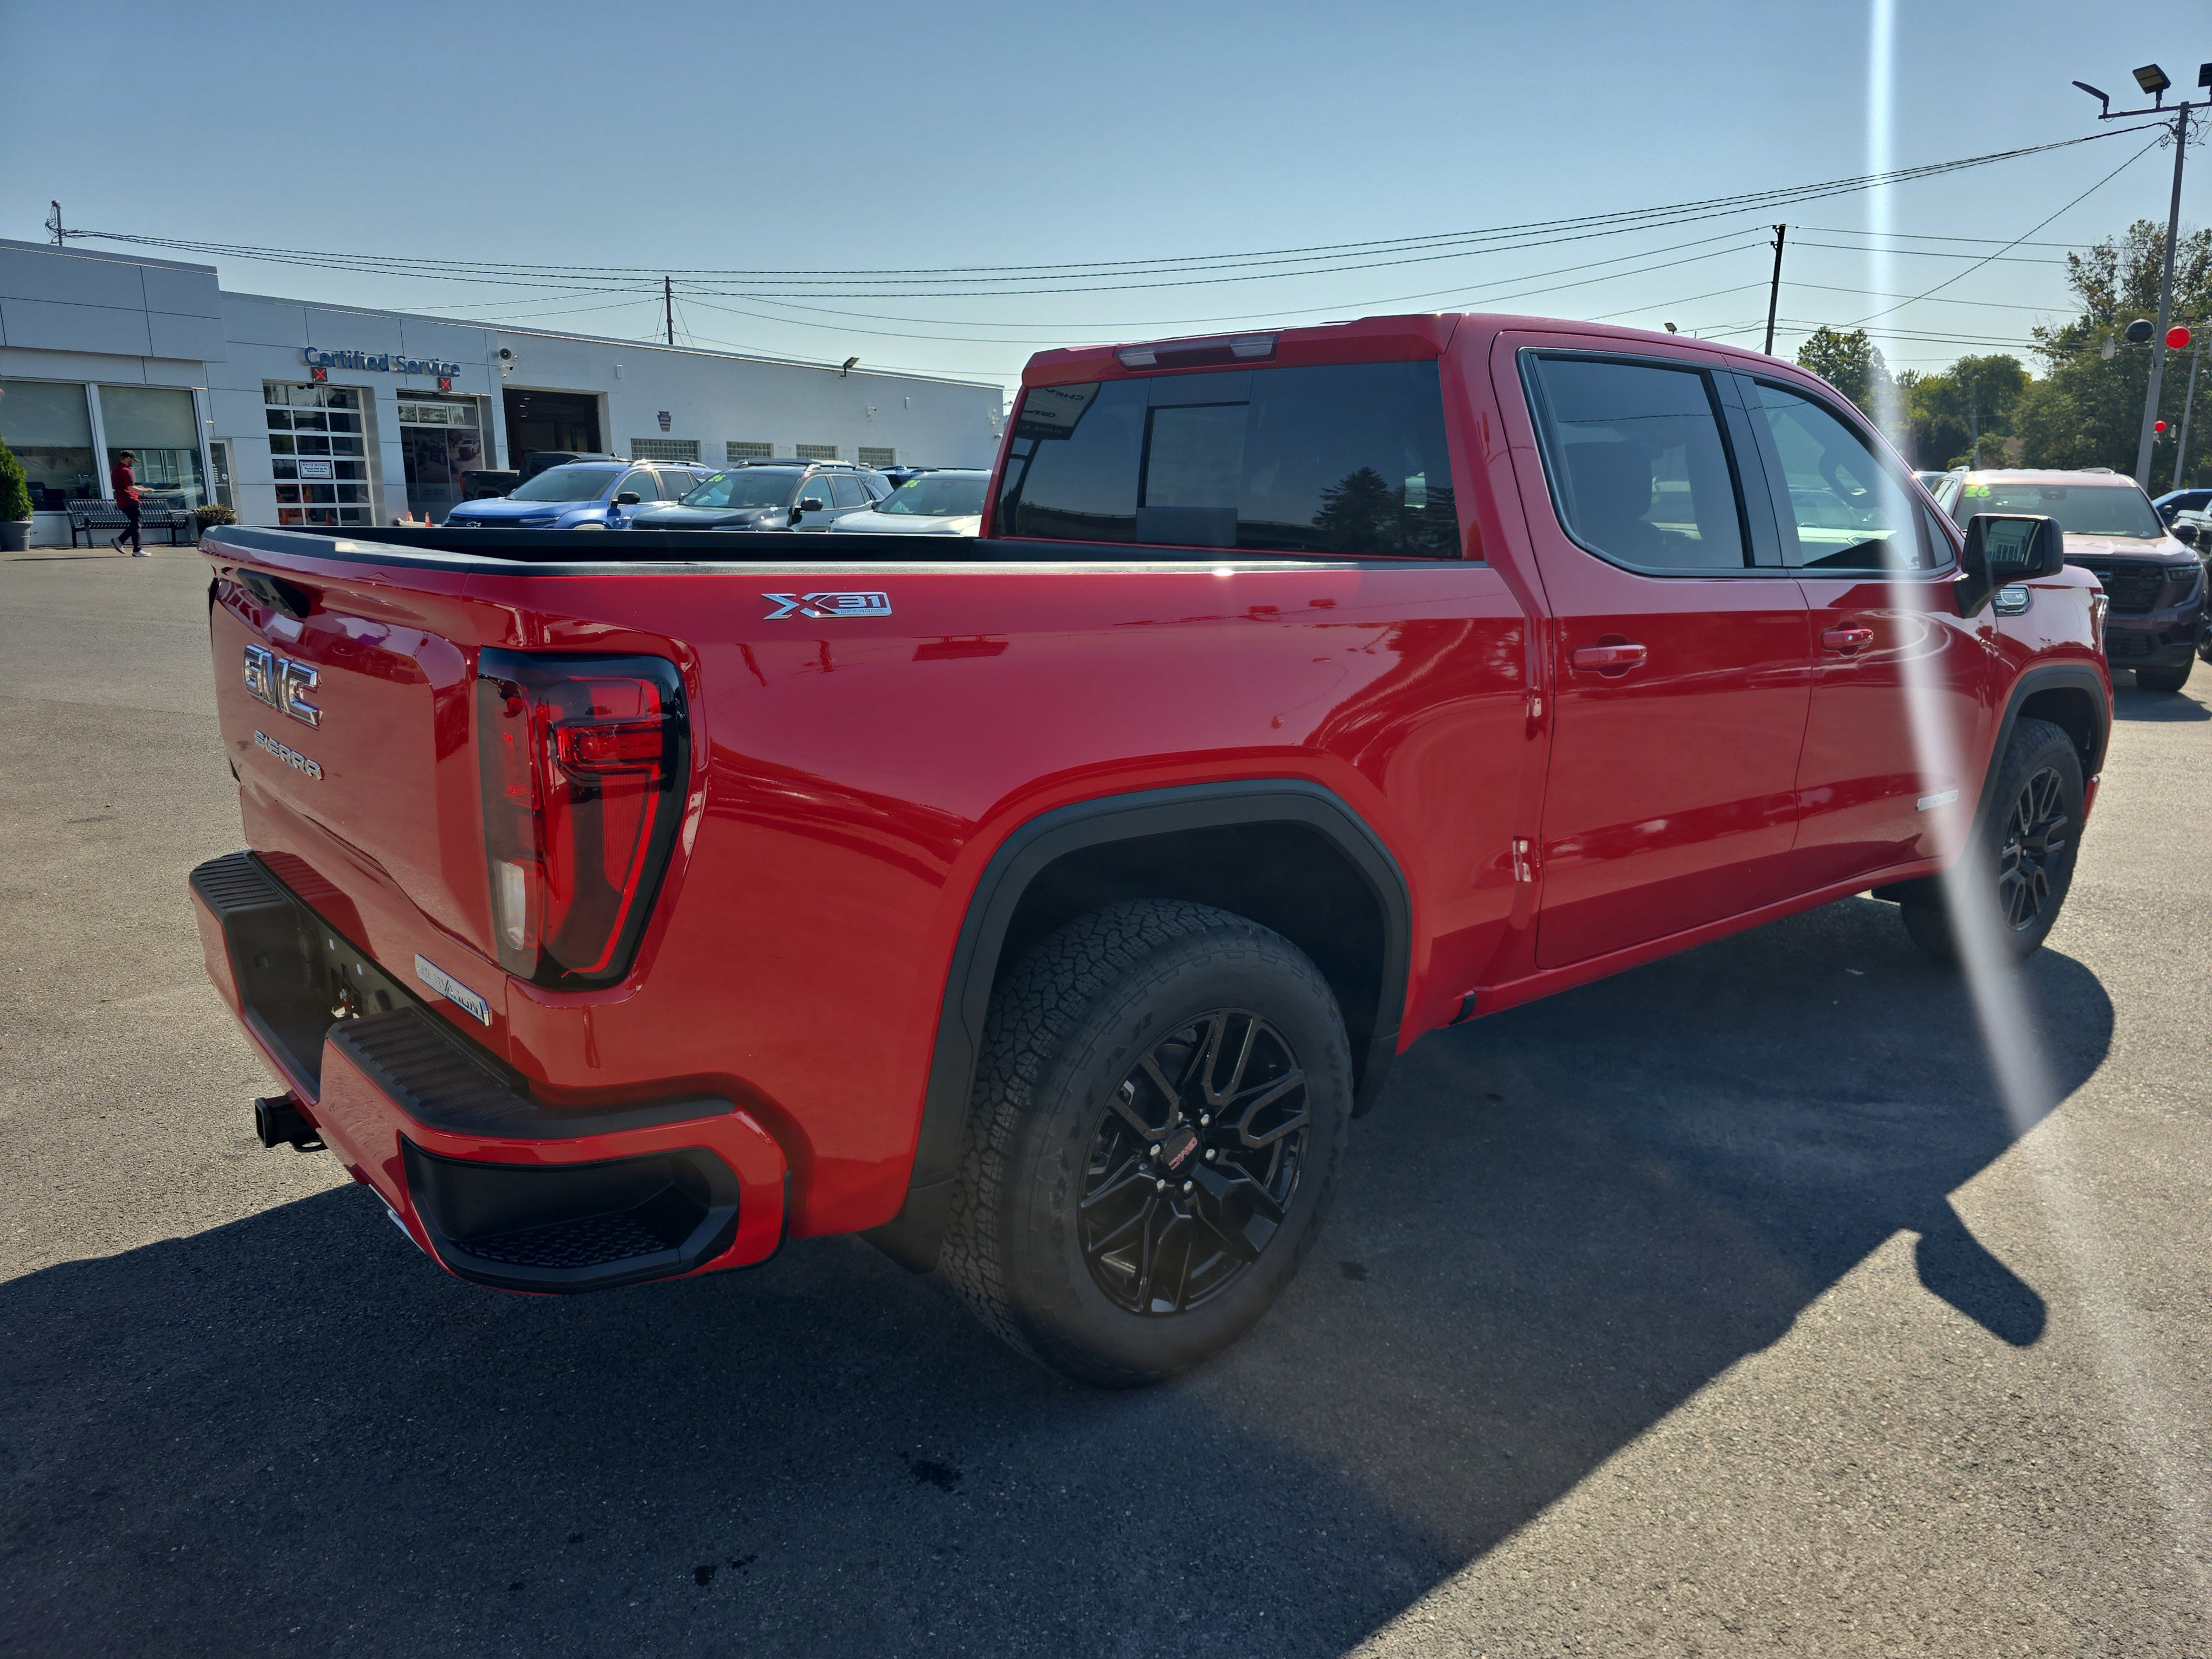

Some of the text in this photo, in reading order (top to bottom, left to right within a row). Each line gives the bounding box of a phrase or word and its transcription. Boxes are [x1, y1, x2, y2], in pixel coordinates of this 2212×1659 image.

[304, 347, 460, 377] Certified Service
[1964, 486, 1991, 497] 26
[243, 643, 322, 728] GMC
[254, 730, 325, 781] SIERRA
[1168, 1136, 1198, 1170] GMC
